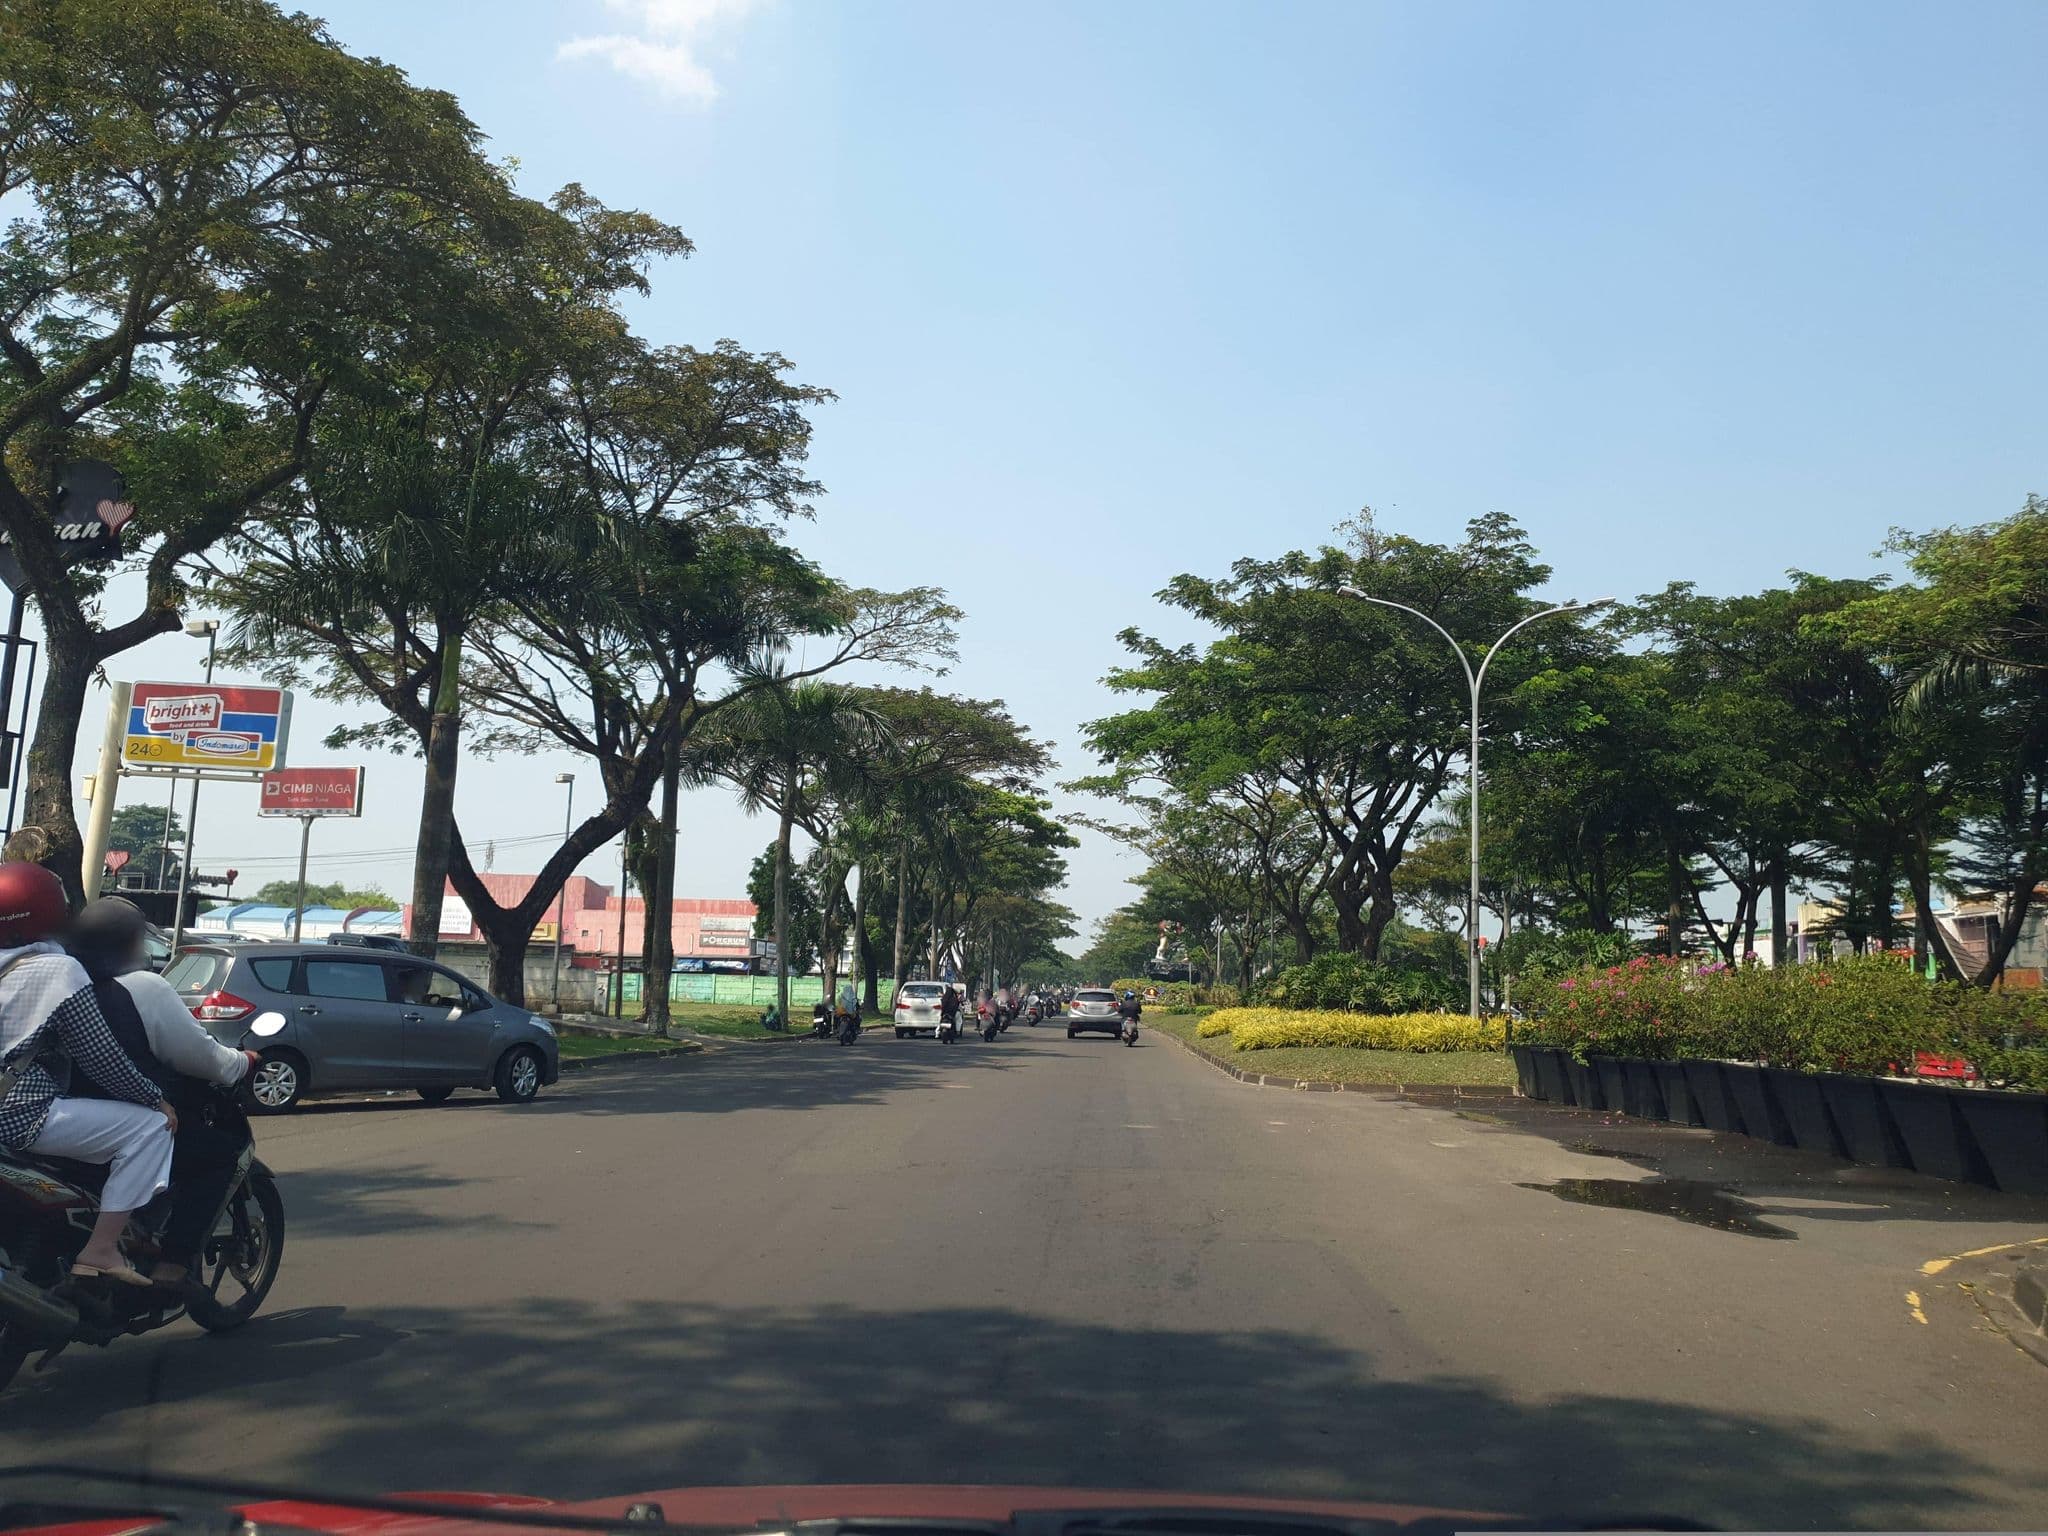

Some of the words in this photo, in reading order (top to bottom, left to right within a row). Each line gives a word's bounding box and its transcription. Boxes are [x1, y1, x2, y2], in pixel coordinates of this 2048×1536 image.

[151, 704, 198, 719] bright
[173, 733, 186, 743] by
[282, 783, 313, 794] CIMB
[315, 783, 352, 794] NIAGA
